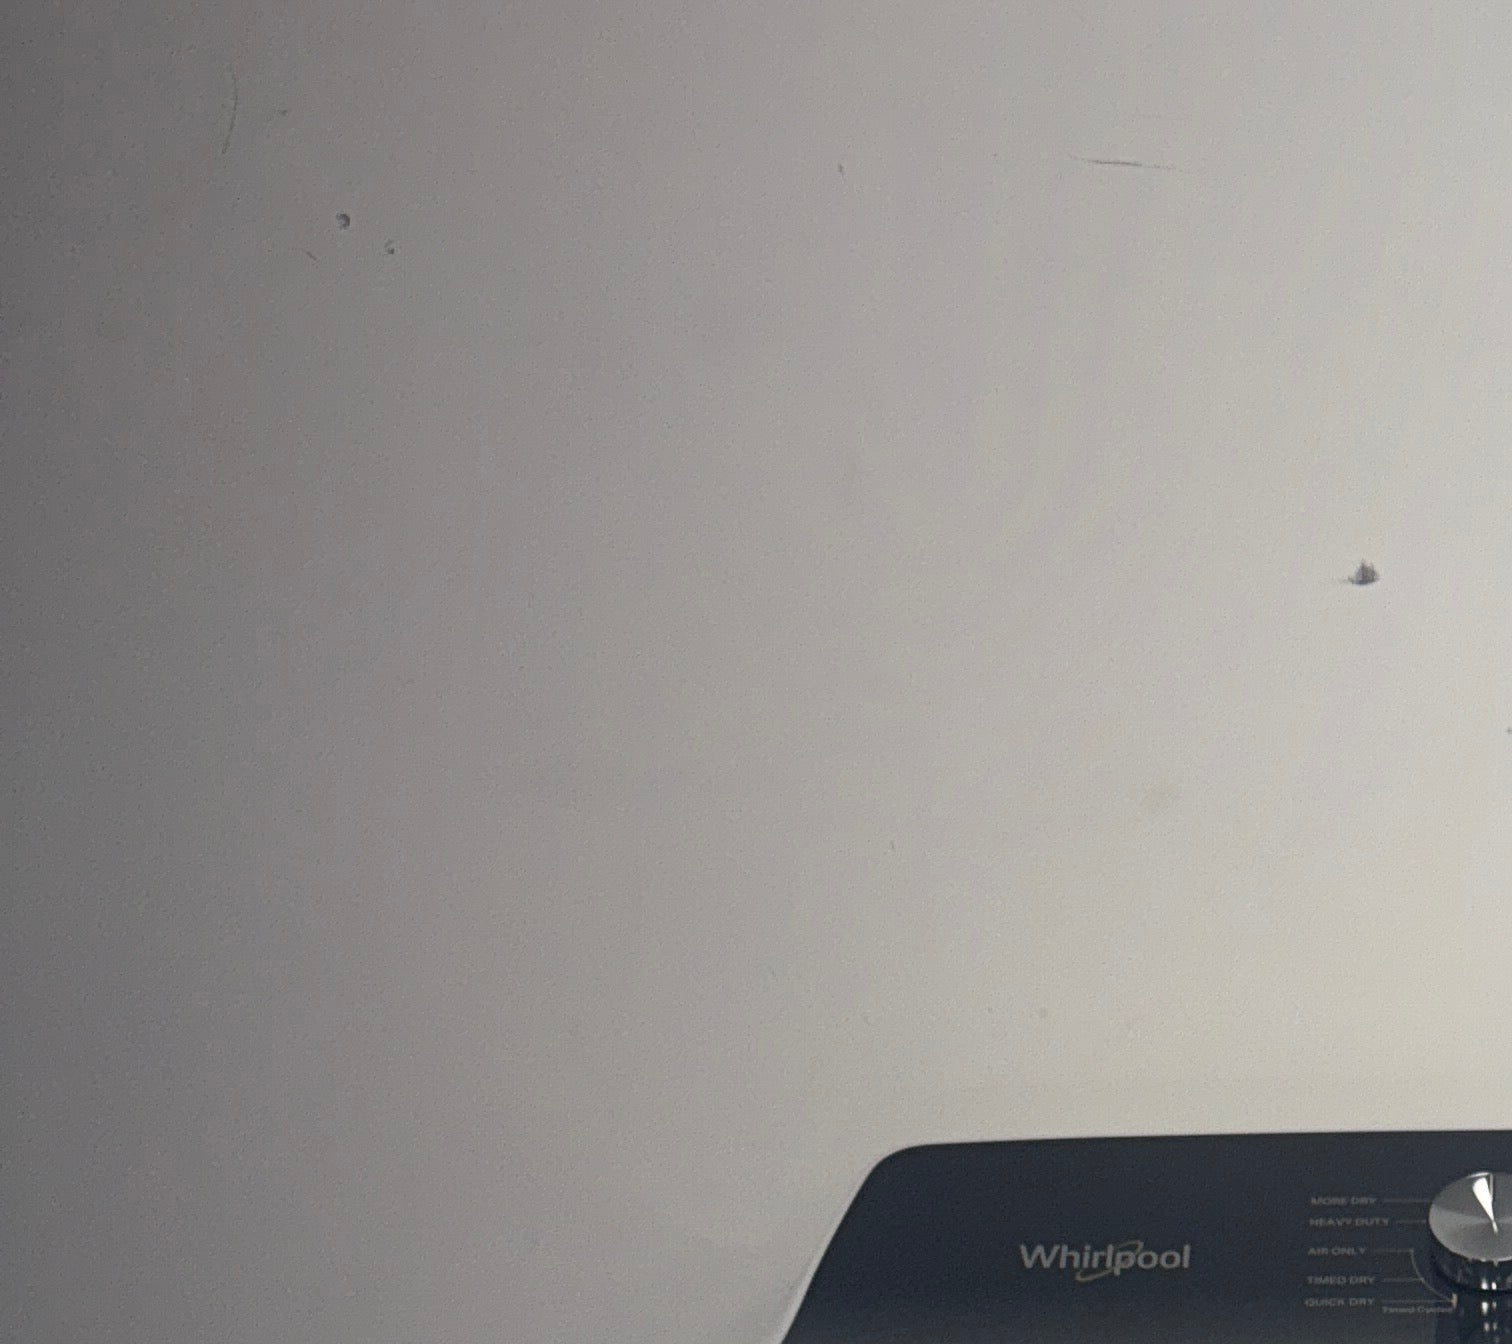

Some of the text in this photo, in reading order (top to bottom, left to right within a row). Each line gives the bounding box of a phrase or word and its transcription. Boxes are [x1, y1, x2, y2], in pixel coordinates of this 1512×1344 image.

[1350, 1196, 1377, 1205] DRY
[1309, 1217, 1389, 1227] HEAVY DUTY
[1307, 1247, 1366, 1256] AIR ONLY
[1019, 1243, 1191, 1276] Whirlpool
[1306, 1275, 1376, 1285] TIMED DRY
[1304, 1297, 1375, 1307] QUICK DRY
